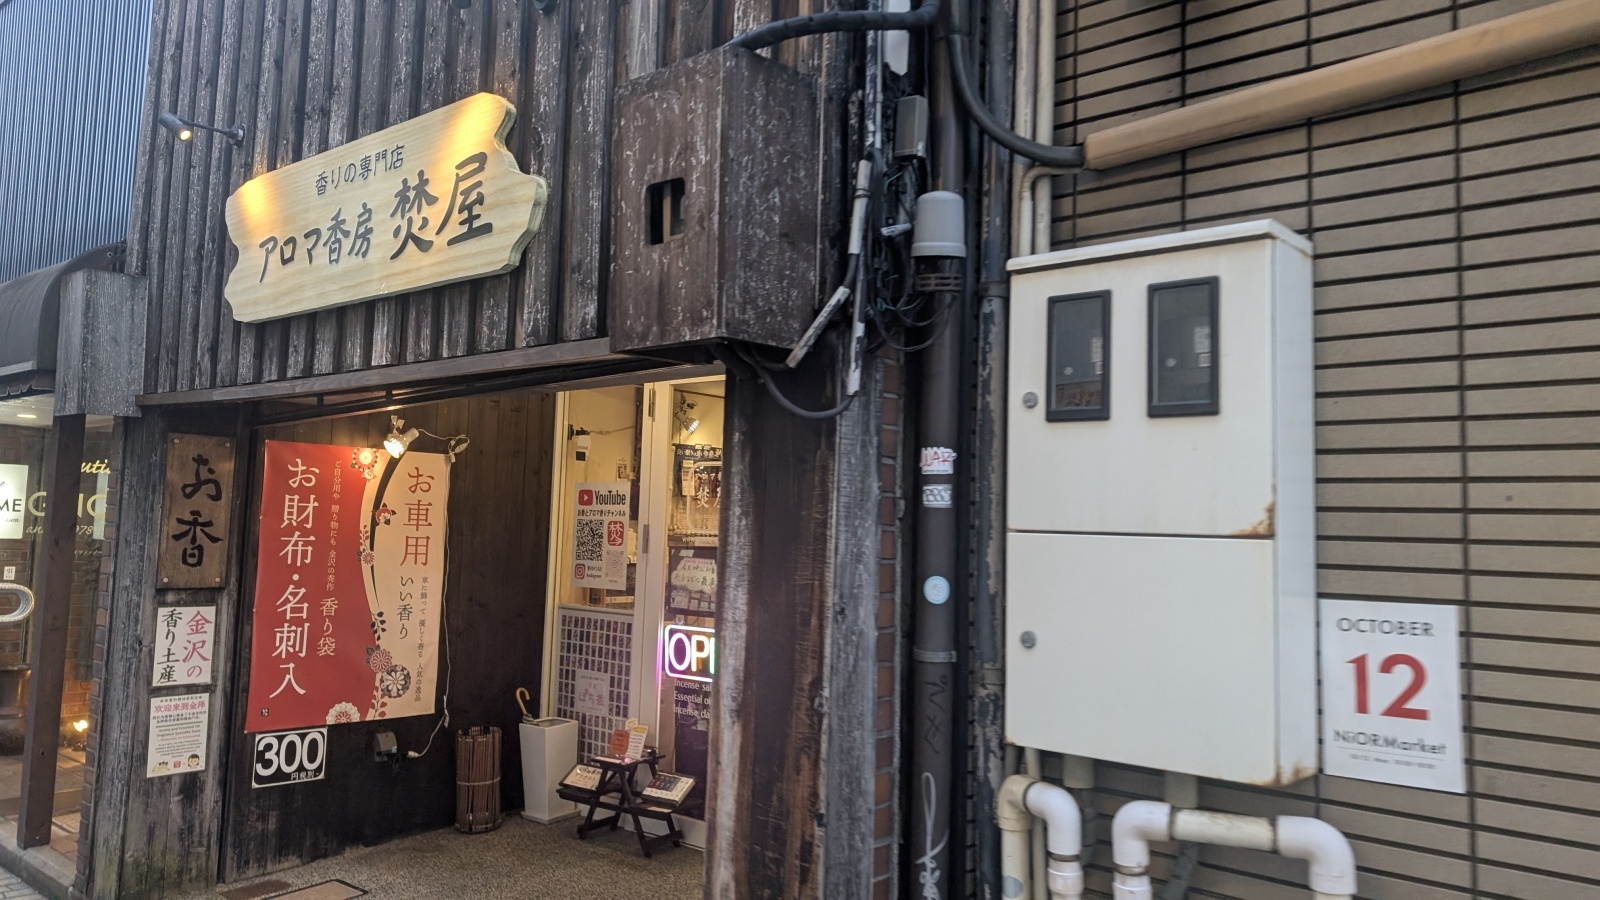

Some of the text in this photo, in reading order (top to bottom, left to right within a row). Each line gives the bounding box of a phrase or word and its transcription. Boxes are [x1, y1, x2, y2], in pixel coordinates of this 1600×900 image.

[315, 144, 404, 196] 香りの専門店
[258, 151, 493, 283] アロマ香房 焚屋
[332, 460, 342, 500] ご自分用や
[594, 489, 626, 506] YouTube
[171, 454, 224, 568] お香
[330, 504, 339, 546] 贈り物にも
[400, 466, 435, 567] お車用
[269, 458, 320, 698] お財布・名刺入
[316, 597, 339, 658] 香り袋
[396, 575, 414, 640] いい香り
[1336, 617, 1434, 637] OCTOBER
[156, 608, 183, 684] 香り土産
[182, 610, 213, 678] 金沢の
[673, 691, 702, 704] Essential
[673, 704, 698, 717] Incense
[674, 679, 699, 690] Incense
[1345, 653, 1430, 721] 12
[256, 731, 324, 776] 300
